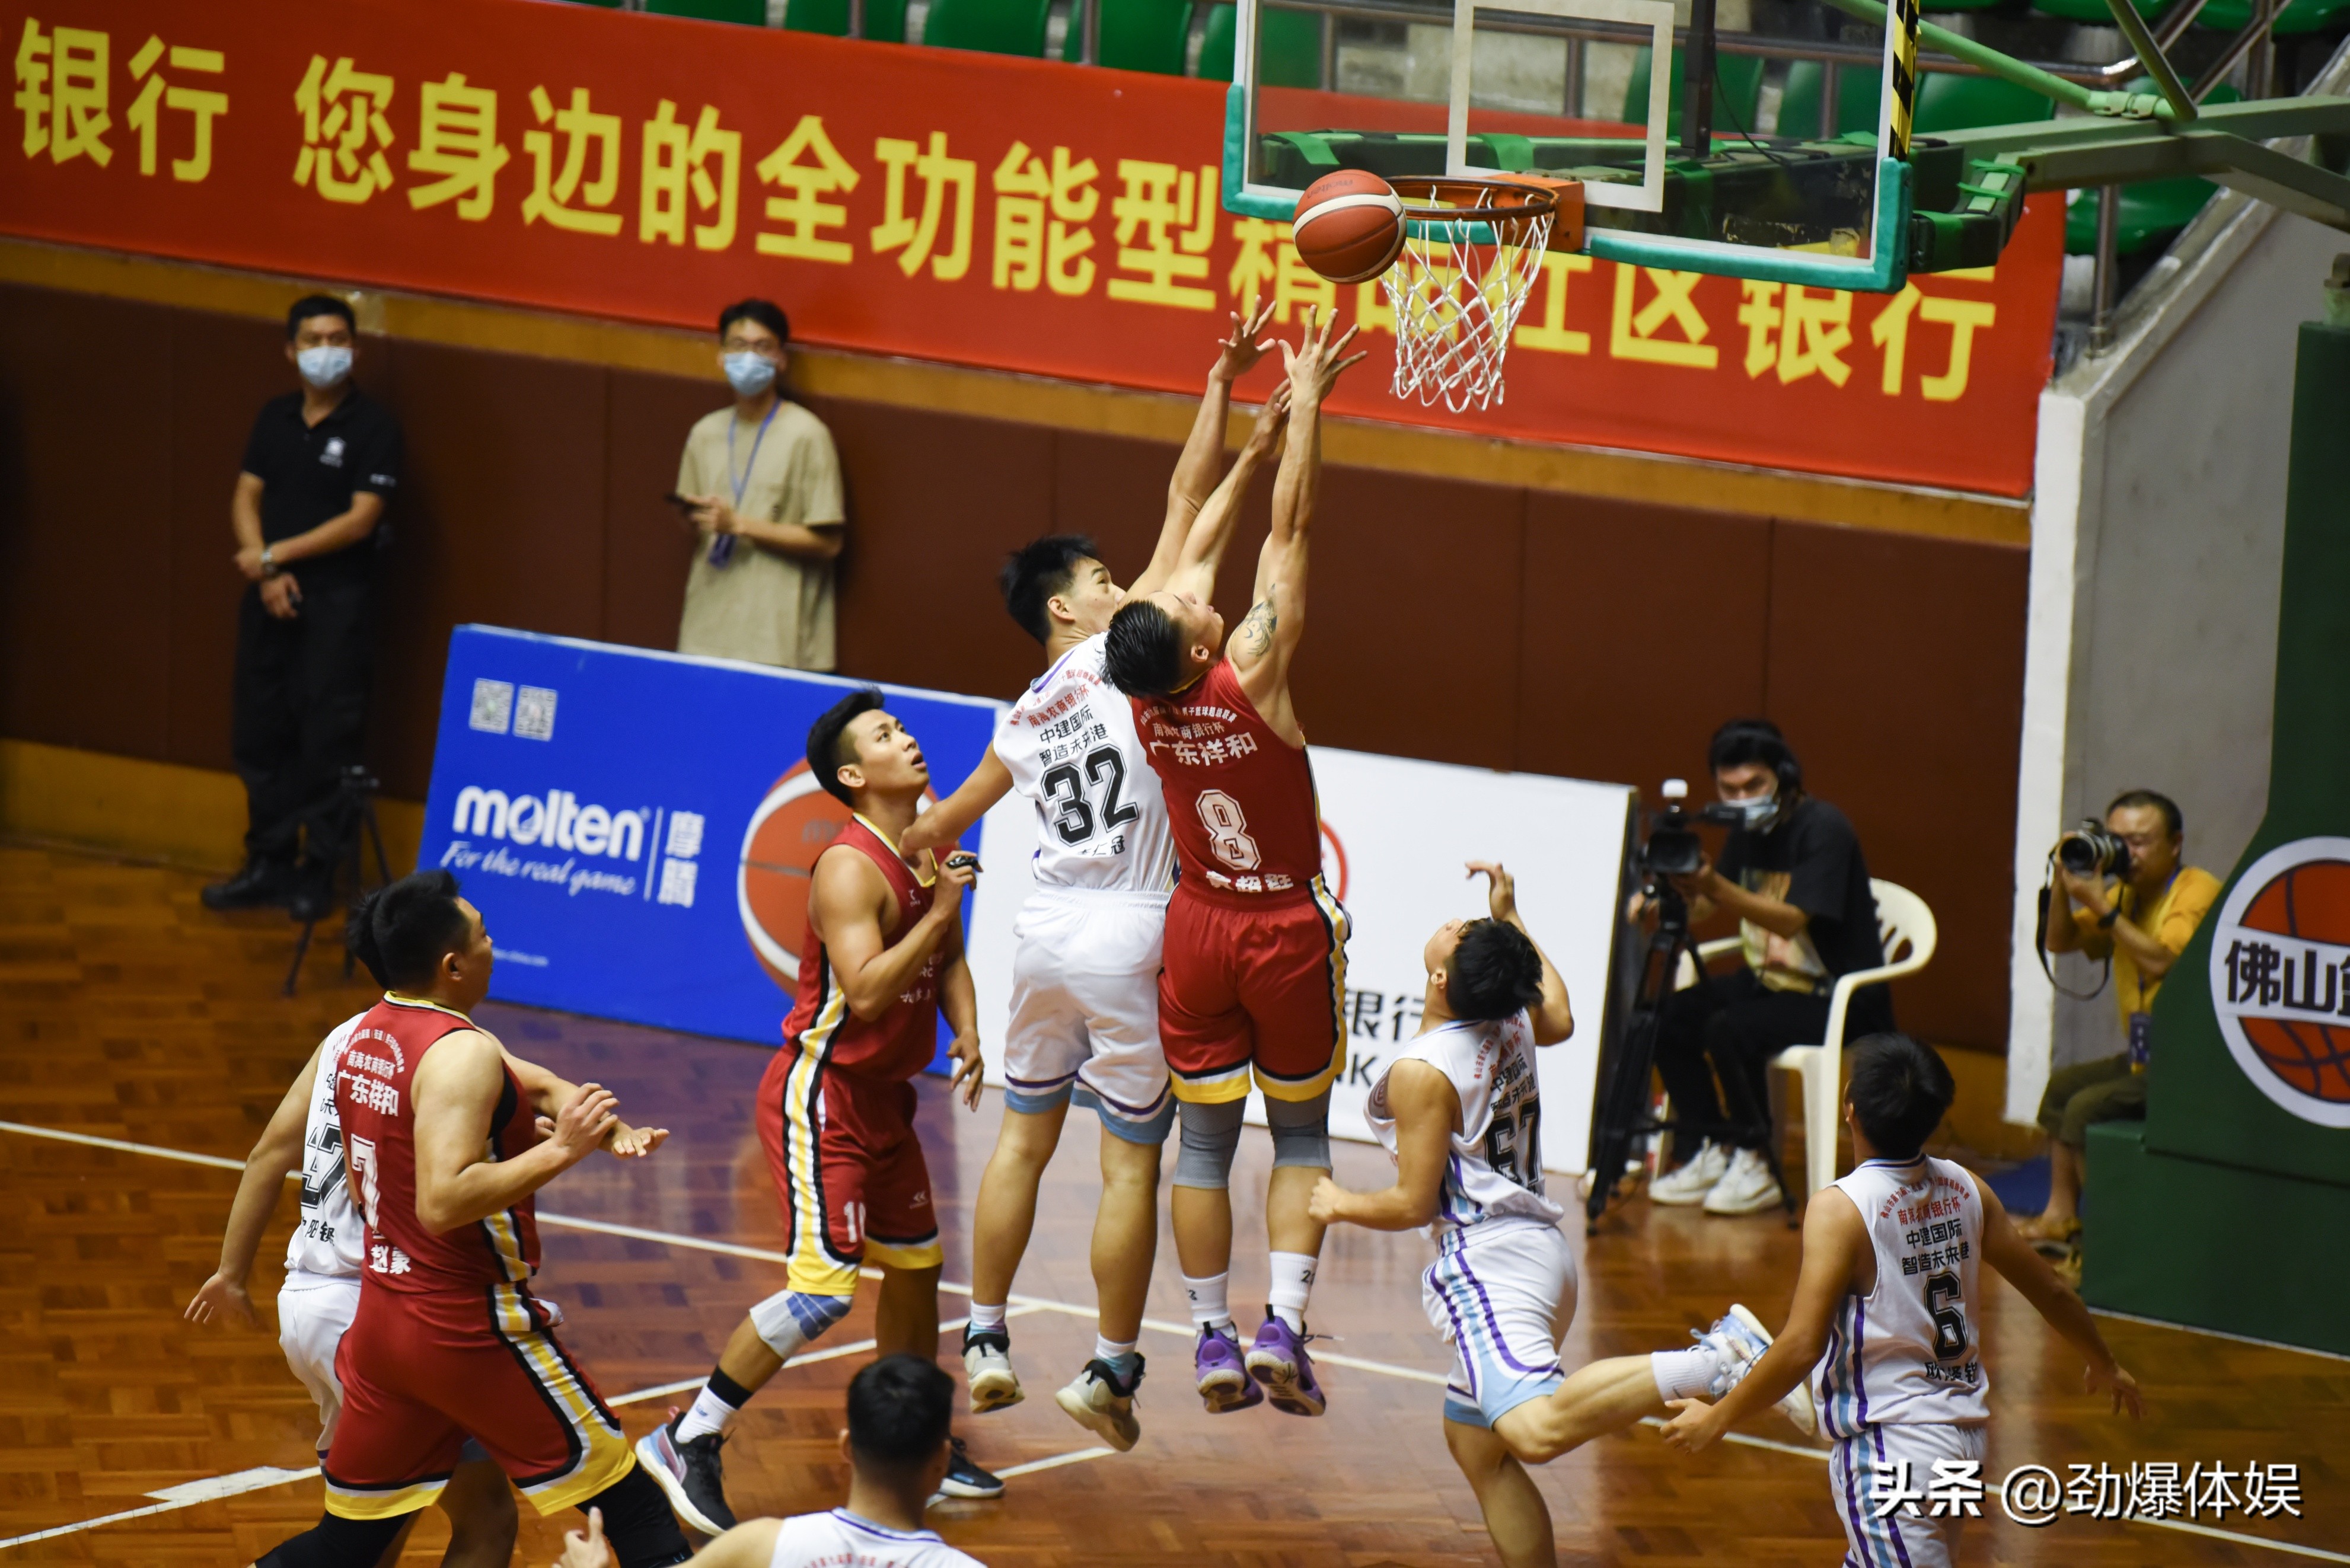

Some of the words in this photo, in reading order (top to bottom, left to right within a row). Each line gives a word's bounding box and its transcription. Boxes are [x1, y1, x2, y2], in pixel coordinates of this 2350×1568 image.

[14, 17, 229, 182] 银行
[1027, 684, 1090, 728] 南海农商银行杯
[1040, 704, 1093, 743] 中建国际
[1039, 723, 1109, 767] 智造未来港
[1149, 732, 1258, 767] 广东祥和
[452, 785, 645, 862] molten
[1040, 743, 1140, 848] 32
[1195, 789, 1262, 871] 8
[439, 840, 483, 869] For
[481, 845, 521, 877] the
[520, 857, 576, 886] real
[567, 868, 636, 897] game
[336, 1069, 400, 1117] 广东祥和
[1482, 1093, 1541, 1186] 67
[1906, 1218, 1963, 1249] 中建国际
[1924, 1270, 1968, 1361] 6
